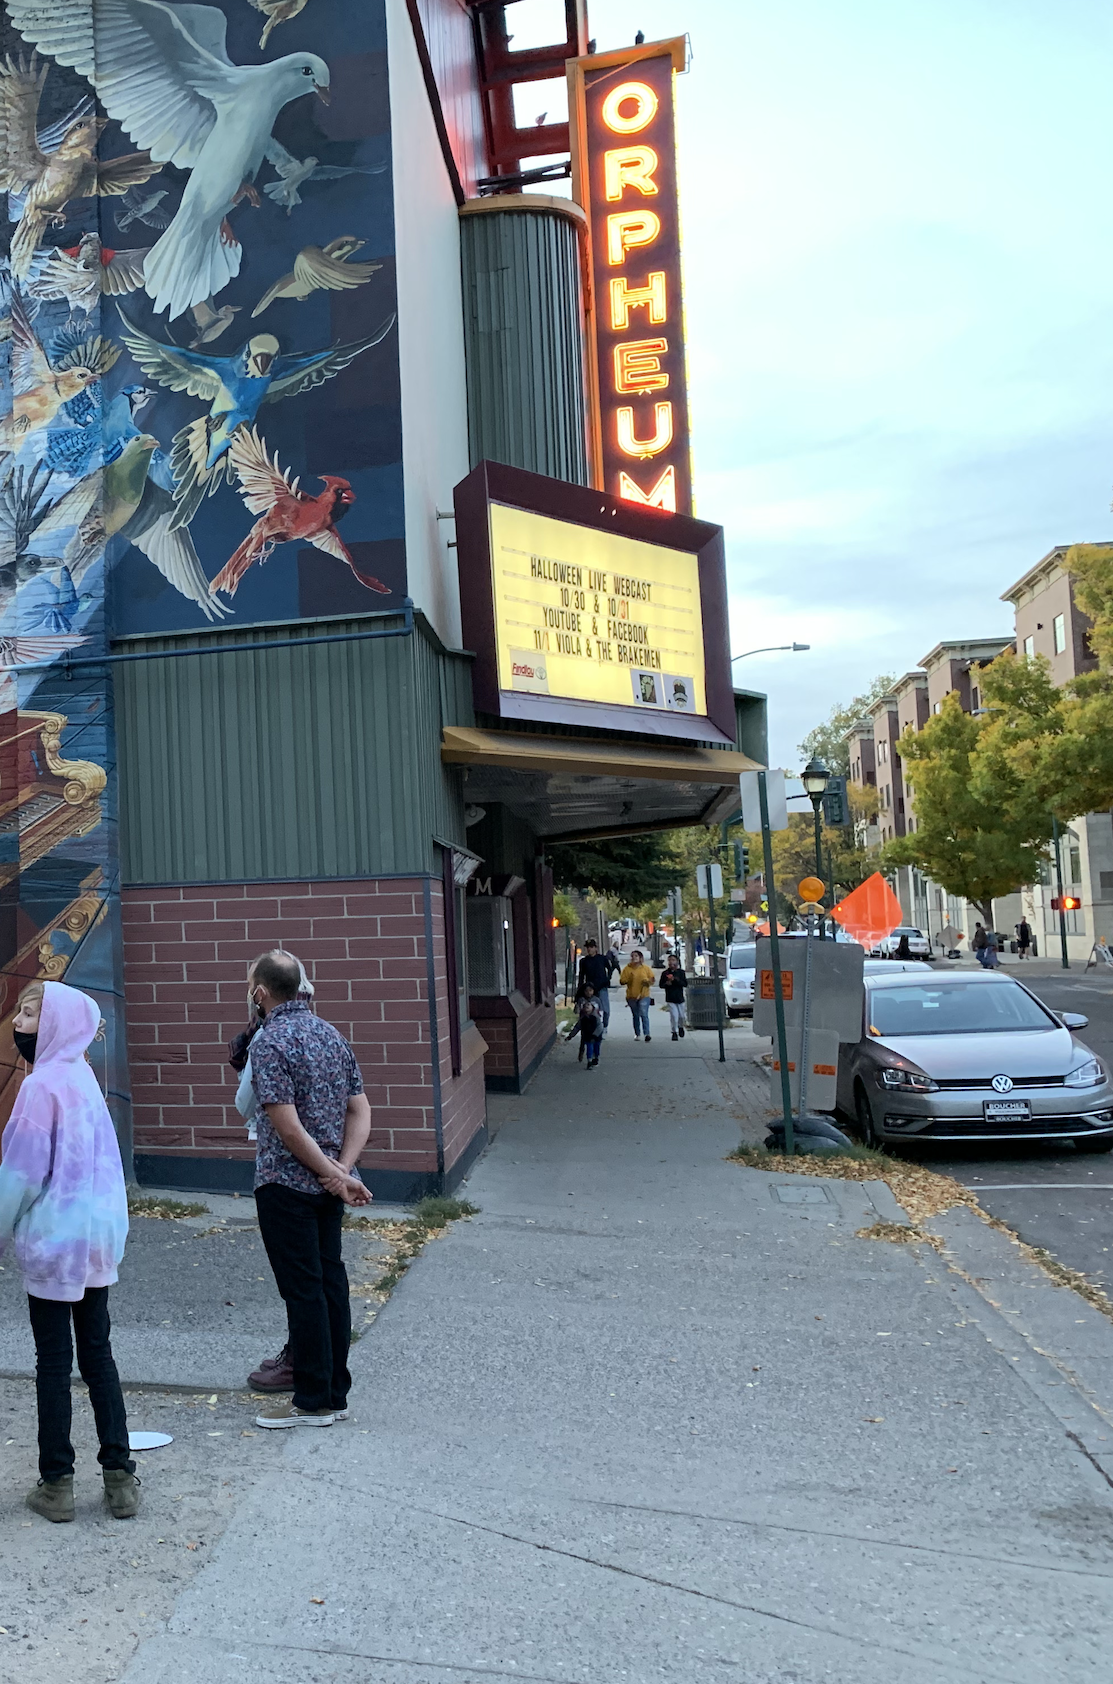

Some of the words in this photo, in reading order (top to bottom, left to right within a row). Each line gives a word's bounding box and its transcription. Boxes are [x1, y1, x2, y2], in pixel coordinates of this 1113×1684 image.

[601, 80, 678, 514] ORPHEUM
[531, 557, 582, 587] HALLOWEEN
[588, 569, 607, 592] LIVE
[613, 575, 651, 601] WEBCAST
[560, 587, 585, 611] 10/30
[593, 594, 600, 613] &
[608, 598, 629, 619] 10/31
[543, 606, 582, 632] YOUTUBE
[592, 616, 598, 635] &
[607, 620, 649, 645] FACEBOOK
[534, 629, 550, 651] 11/1
[556, 632, 582, 656] VIOLA
[586, 638, 592, 658] &
[596, 640, 612, 660] THE
[618, 644, 661, 669] BRAKEMEN
